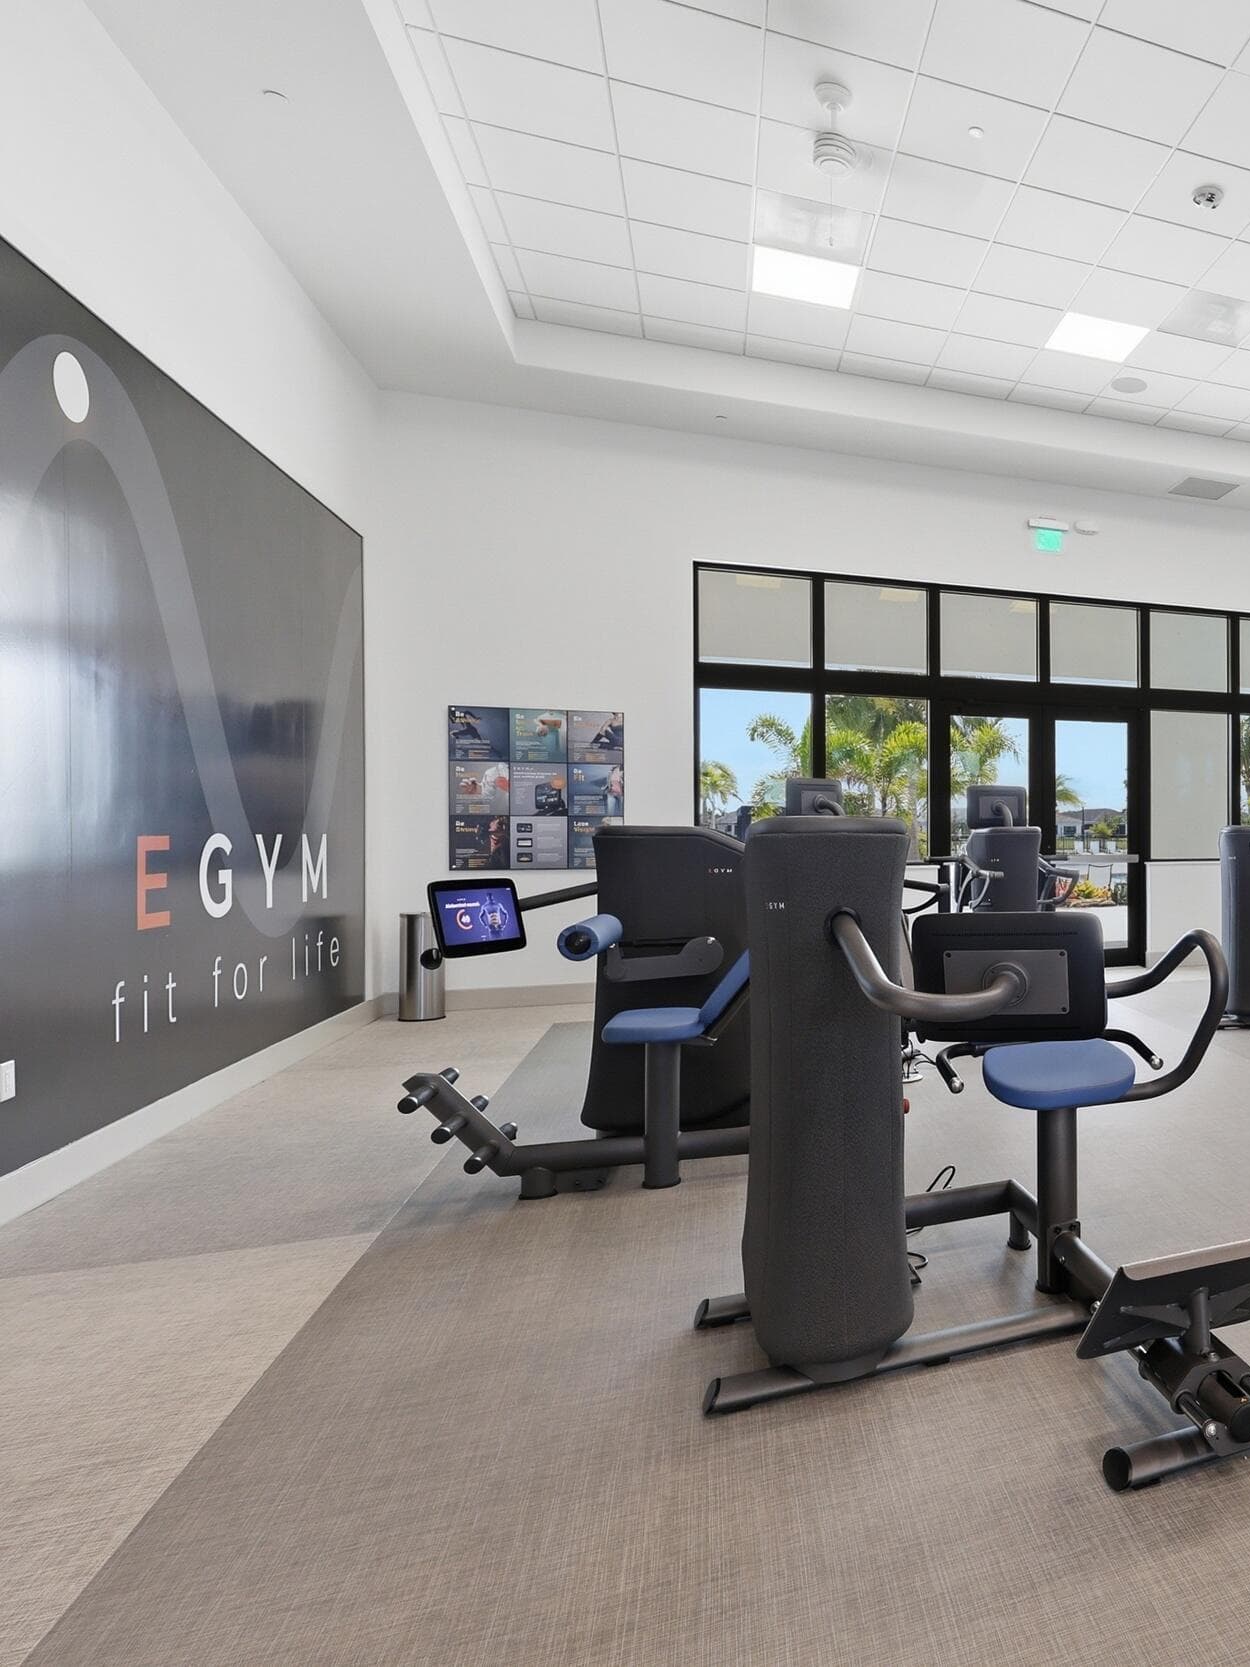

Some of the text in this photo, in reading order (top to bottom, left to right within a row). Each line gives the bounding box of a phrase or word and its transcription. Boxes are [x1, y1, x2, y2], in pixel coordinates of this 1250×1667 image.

[136, 832, 328, 931] EGYM
[111, 931, 340, 1042] fit for life
